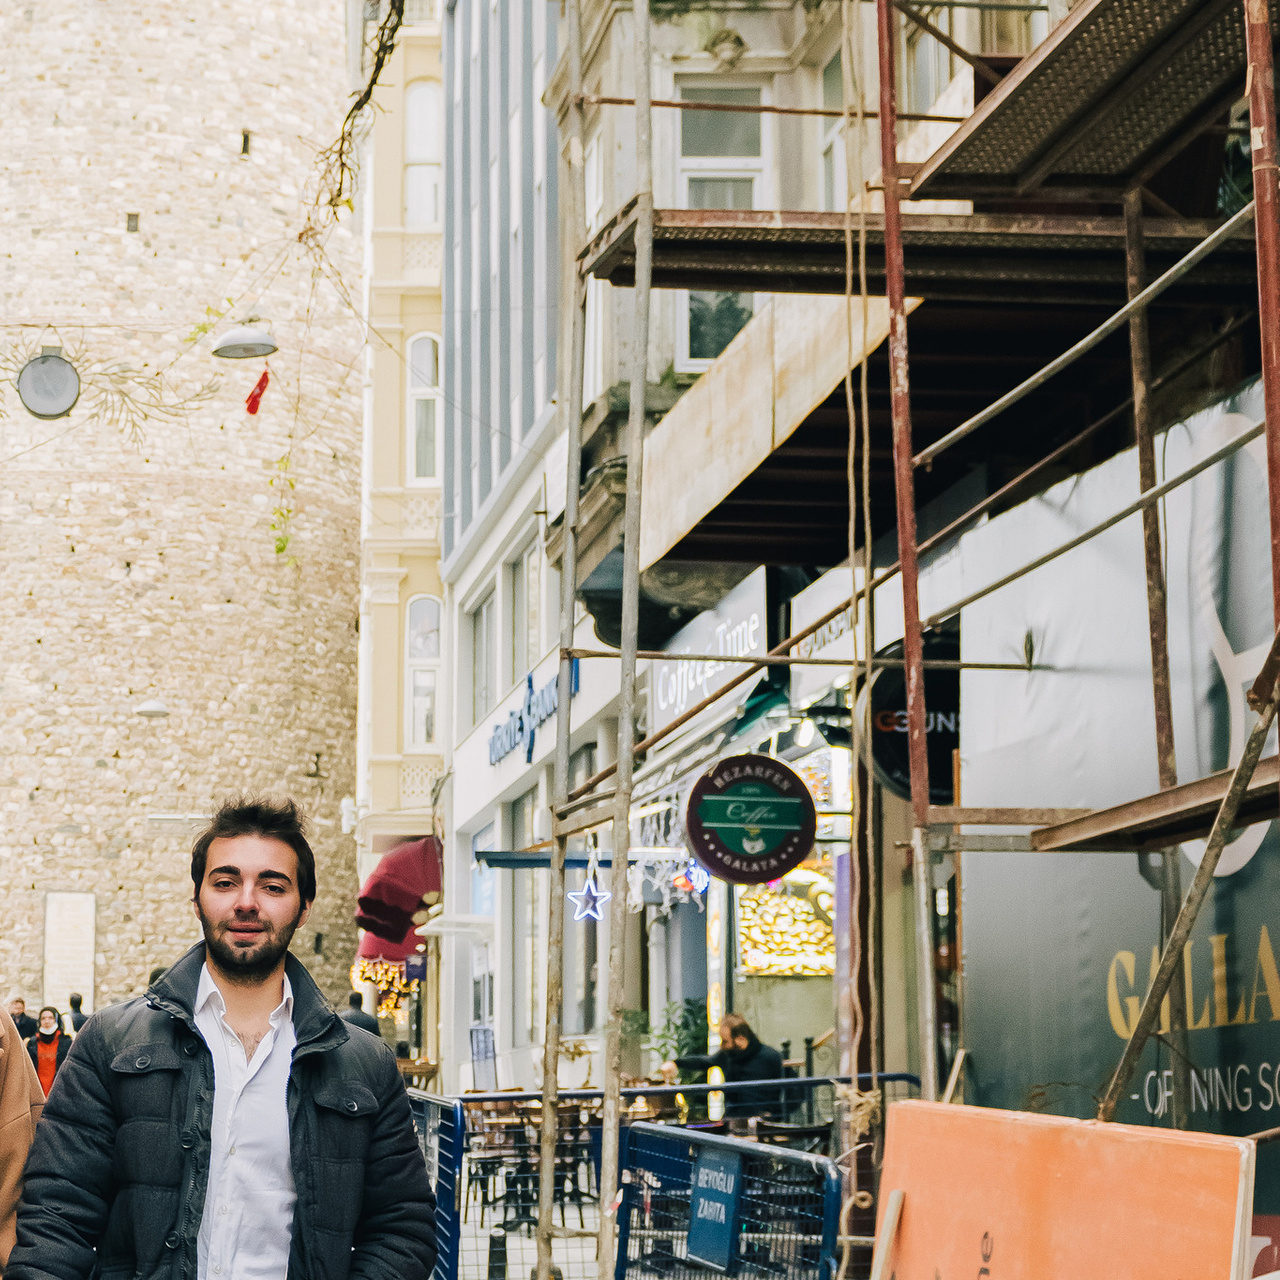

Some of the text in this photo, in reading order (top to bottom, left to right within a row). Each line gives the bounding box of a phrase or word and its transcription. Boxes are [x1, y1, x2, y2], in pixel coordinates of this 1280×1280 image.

[715, 613, 760, 666] Time
[713, 764, 793, 792] HEZARFEN
[726, 802, 778, 823] Coffee
[723, 854, 778, 871] GALATA
[698, 1166, 735, 1194] BEYOĞLU
